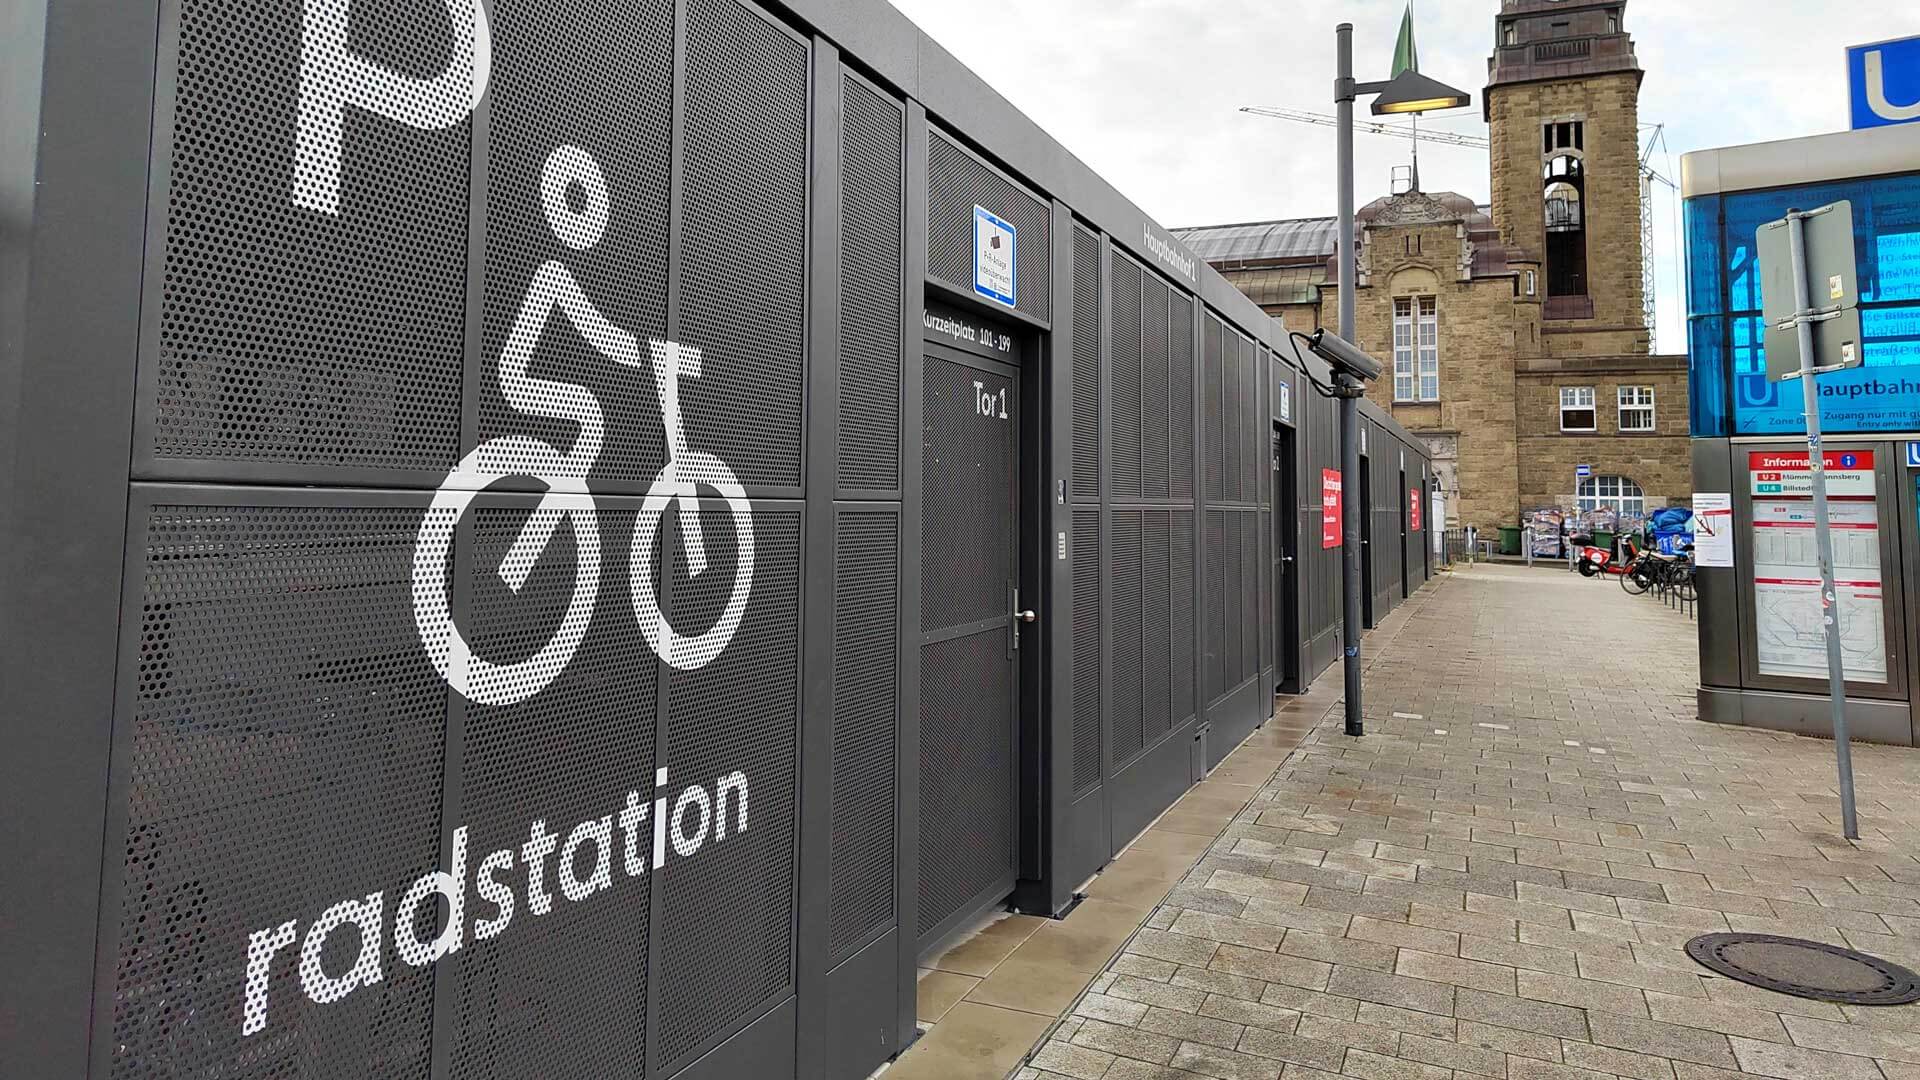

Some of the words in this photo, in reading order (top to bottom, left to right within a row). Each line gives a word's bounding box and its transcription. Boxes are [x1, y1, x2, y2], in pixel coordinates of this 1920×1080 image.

[293, 0, 492, 216] P
[979, 327, 993, 347] 101
[998, 334, 1011, 352] 199
[973, 380, 997, 417] Tor
[999, 387, 1008, 419] 1
[1768, 416, 1794, 426] Zone
[1823, 411, 1865, 421] Zugang
[1867, 411, 1885, 419] nur
[1888, 409, 1906, 418] mit
[1763, 456, 1834, 467] Informaon
[242, 767, 749, 1036] radstation
